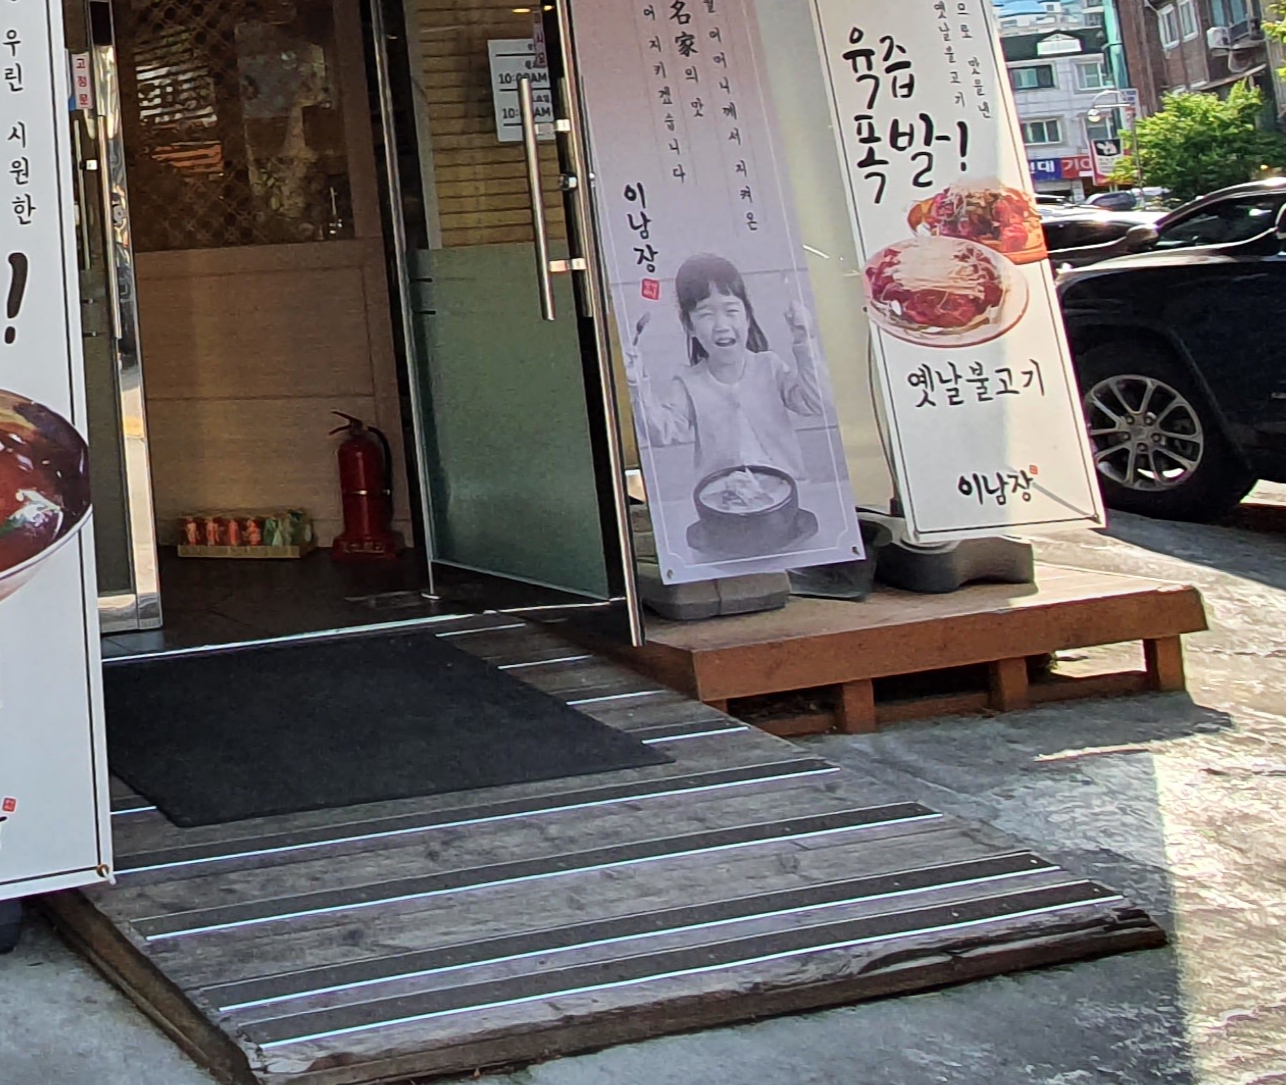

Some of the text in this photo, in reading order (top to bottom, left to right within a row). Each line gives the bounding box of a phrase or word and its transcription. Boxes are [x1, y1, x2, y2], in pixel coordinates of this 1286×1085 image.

[2, 29, 24, 92] 우린
[842, 26, 915, 110] 육즙
[933, 0, 966, 108] 옛날불고기
[649, 36, 686, 183] 지키겠습니다
[691, 97, 705, 117] 맛
[709, 27, 742, 145] 어머니께서
[735, 159, 758, 231] 지켜온
[8, 121, 36, 225] 시원한
[854, 113, 968, 204] 폭발!
[624, 182, 659, 273] 이남장
[907, 358, 1045, 407] 옛날불고기
[958, 469, 1034, 506] 이남장
